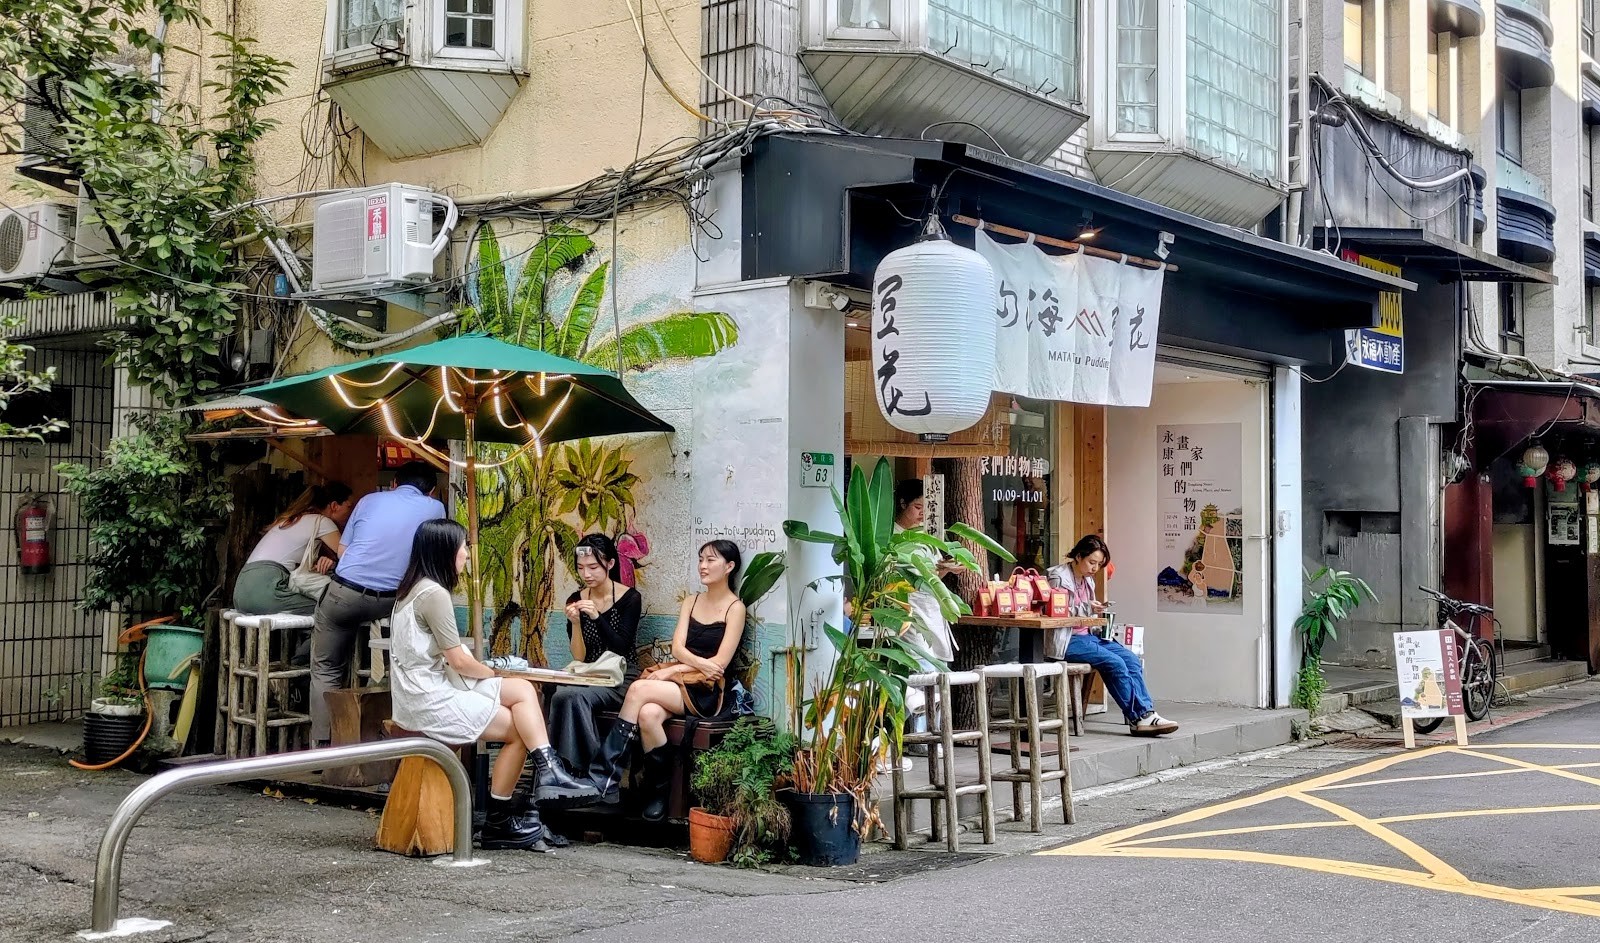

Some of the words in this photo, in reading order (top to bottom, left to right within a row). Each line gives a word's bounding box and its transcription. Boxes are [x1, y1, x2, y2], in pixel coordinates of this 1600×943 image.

[877, 274, 932, 417] 豆花
[1162, 430, 1175, 477] 永康街
[815, 468, 828, 482] 63
[694, 516, 703, 525] IG
[695, 523, 776, 543] mata_tofu_pudding
